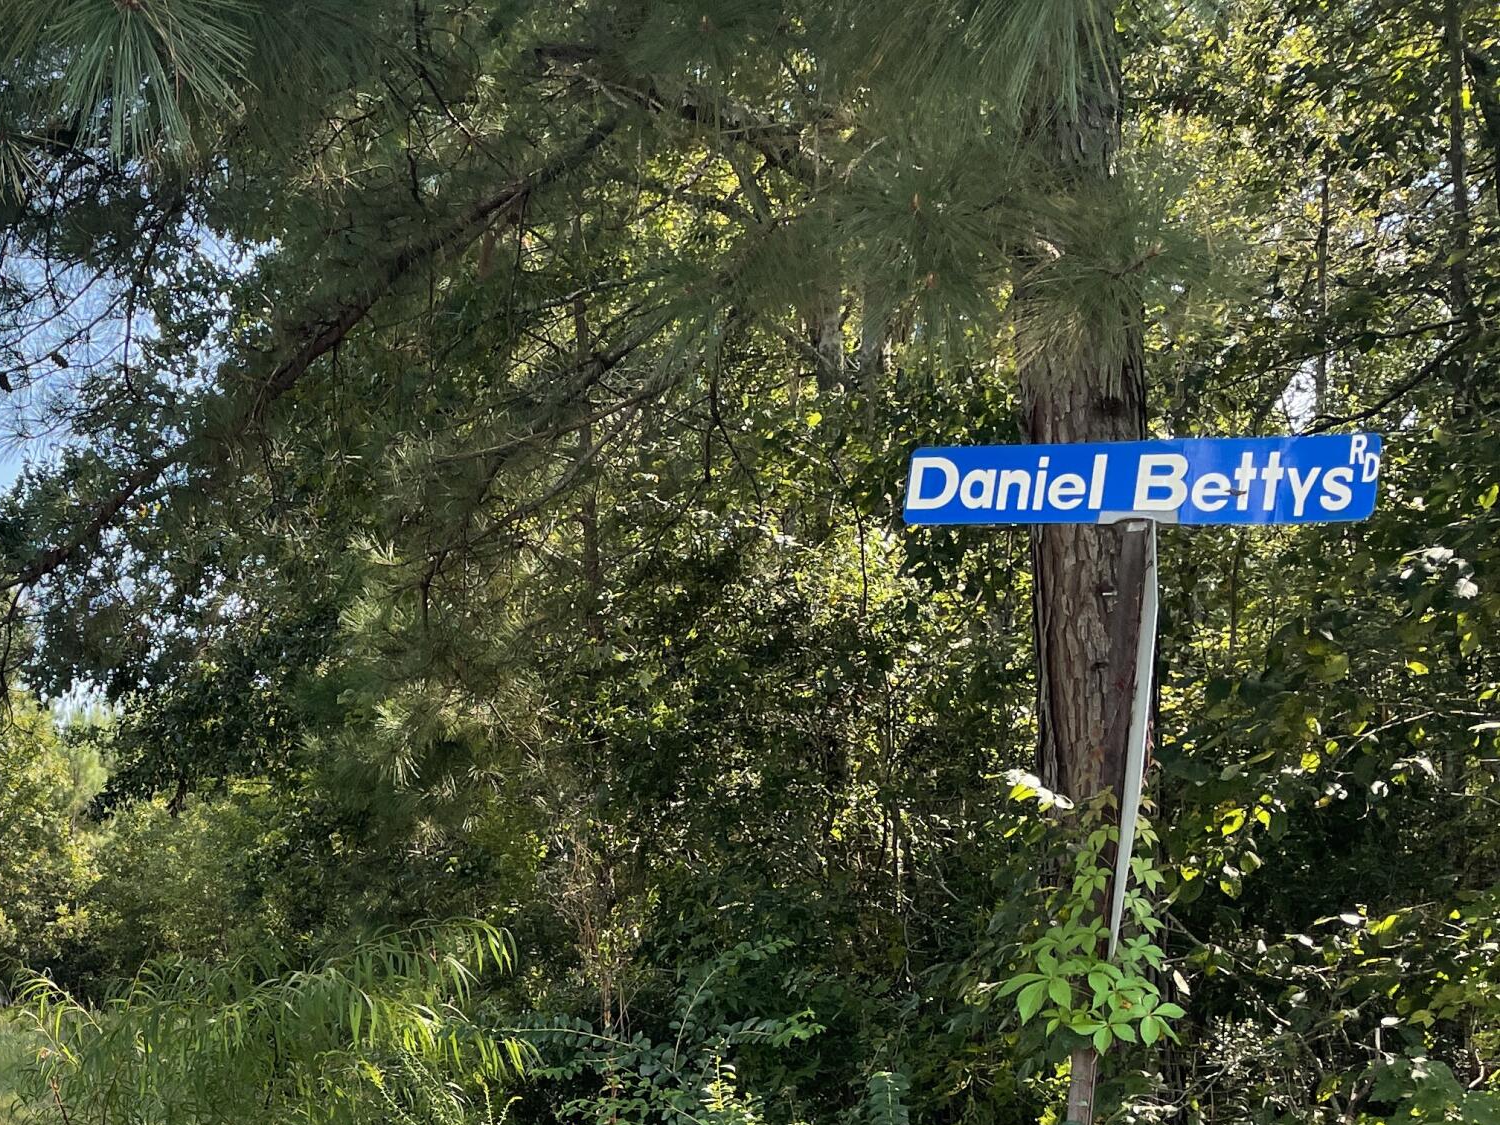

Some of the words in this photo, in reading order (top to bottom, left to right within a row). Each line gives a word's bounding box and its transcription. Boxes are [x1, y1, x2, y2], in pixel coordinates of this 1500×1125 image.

[906, 453, 1108, 510] Daniel
[1133, 451, 1354, 517] Bettys
[1349, 434, 1381, 483] RD
